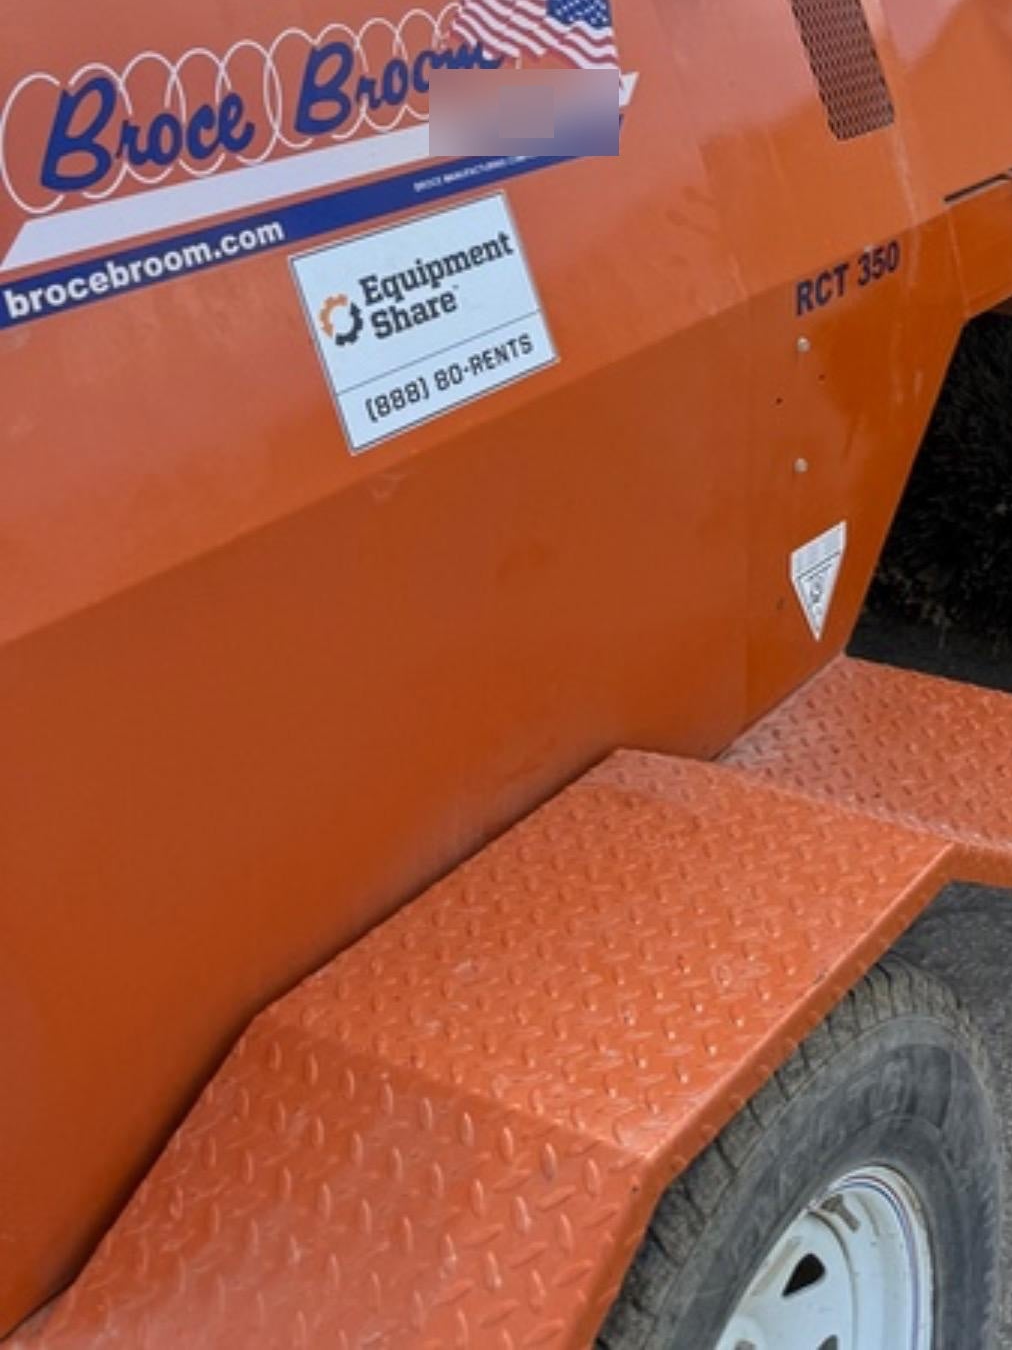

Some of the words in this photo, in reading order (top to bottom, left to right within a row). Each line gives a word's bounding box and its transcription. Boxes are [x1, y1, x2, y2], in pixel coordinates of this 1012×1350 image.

[40, 76, 255, 192] Broce
[4, 219, 285, 319] brocebroom.com
[358, 230, 514, 306] Equipment
[796, 261, 850, 317] RCT
[857, 239, 900, 287] 350
[370, 290, 458, 340] Share
[365, 376, 430, 423] (888)
[433, 333, 535, 392] 80-RENTS
